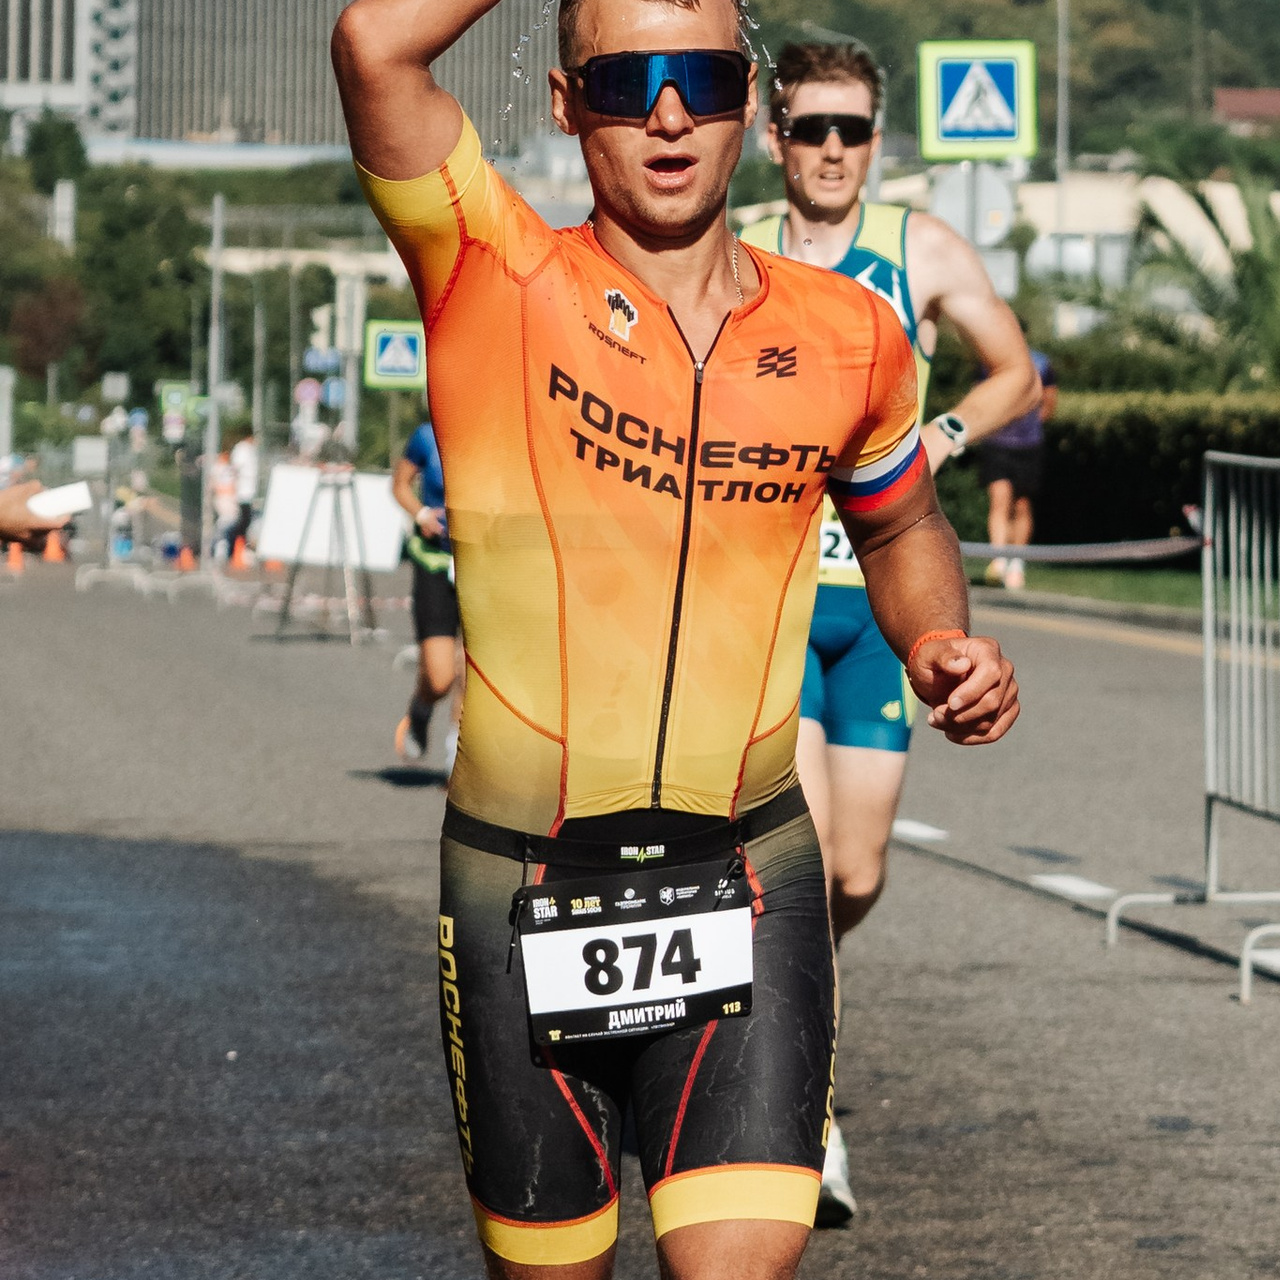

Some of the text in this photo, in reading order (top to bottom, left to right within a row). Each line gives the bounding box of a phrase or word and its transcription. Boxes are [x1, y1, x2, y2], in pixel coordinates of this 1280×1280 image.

[588, 322, 647, 365] ROSNEFT
[548, 363, 838, 474] РОСНЕФТЬ
[569, 427, 807, 504] ТРИАТЛОН
[646, 845, 665, 855] STAR
[534, 905, 558, 919] STAR
[571, 899, 583, 910] 10
[582, 928, 702, 996] 874
[608, 999, 686, 1029] ДМИТРИЙ
[722, 1001, 742, 1015] 113
